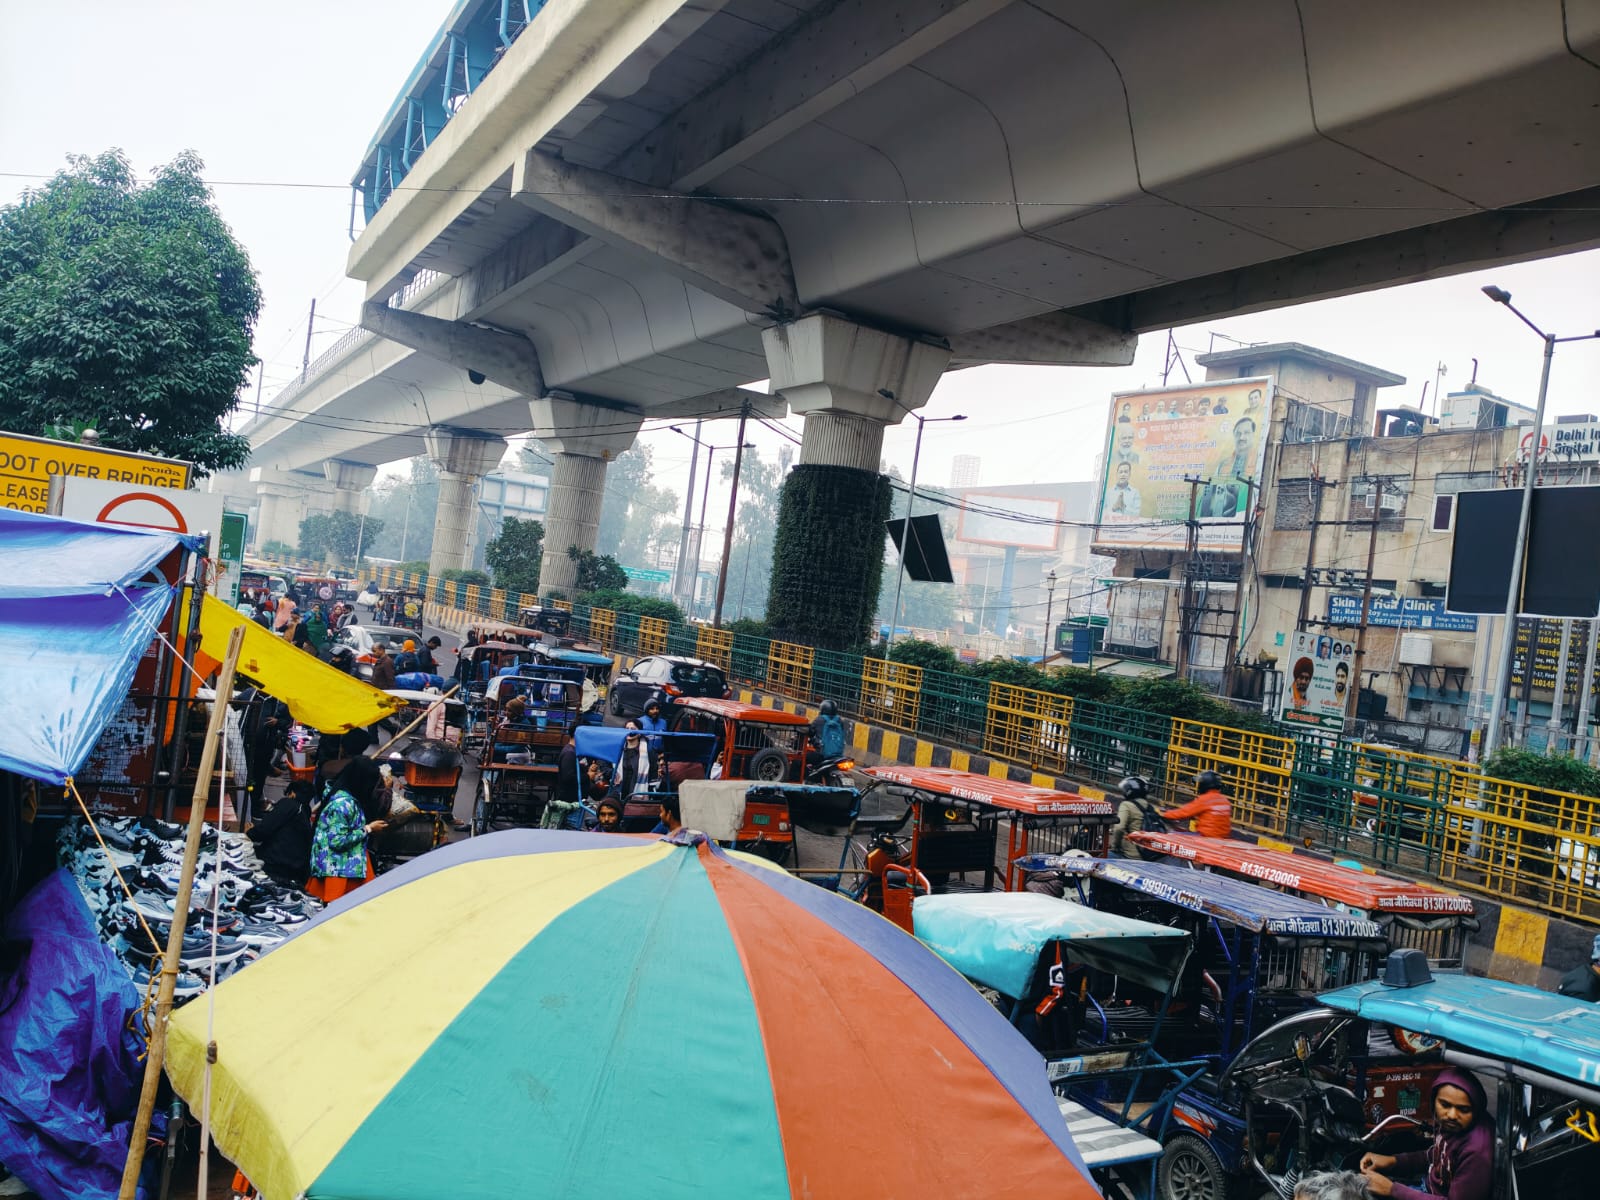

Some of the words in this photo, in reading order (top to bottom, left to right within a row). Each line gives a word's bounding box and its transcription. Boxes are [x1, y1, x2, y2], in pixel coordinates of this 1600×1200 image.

[1556, 428, 1586, 441] Delhi
[0, 452, 40, 473] OOT
[45, 459, 100, 480] OVER
[106, 469, 181, 489] BRIDGE
[0, 483, 48, 502] EASE
[1332, 597, 1356, 608] Skin
[1404, 599, 1436, 611] Clinic
[1240, 861, 1301, 887] 8130120005
[1423, 896, 1473, 912] 8130120005
